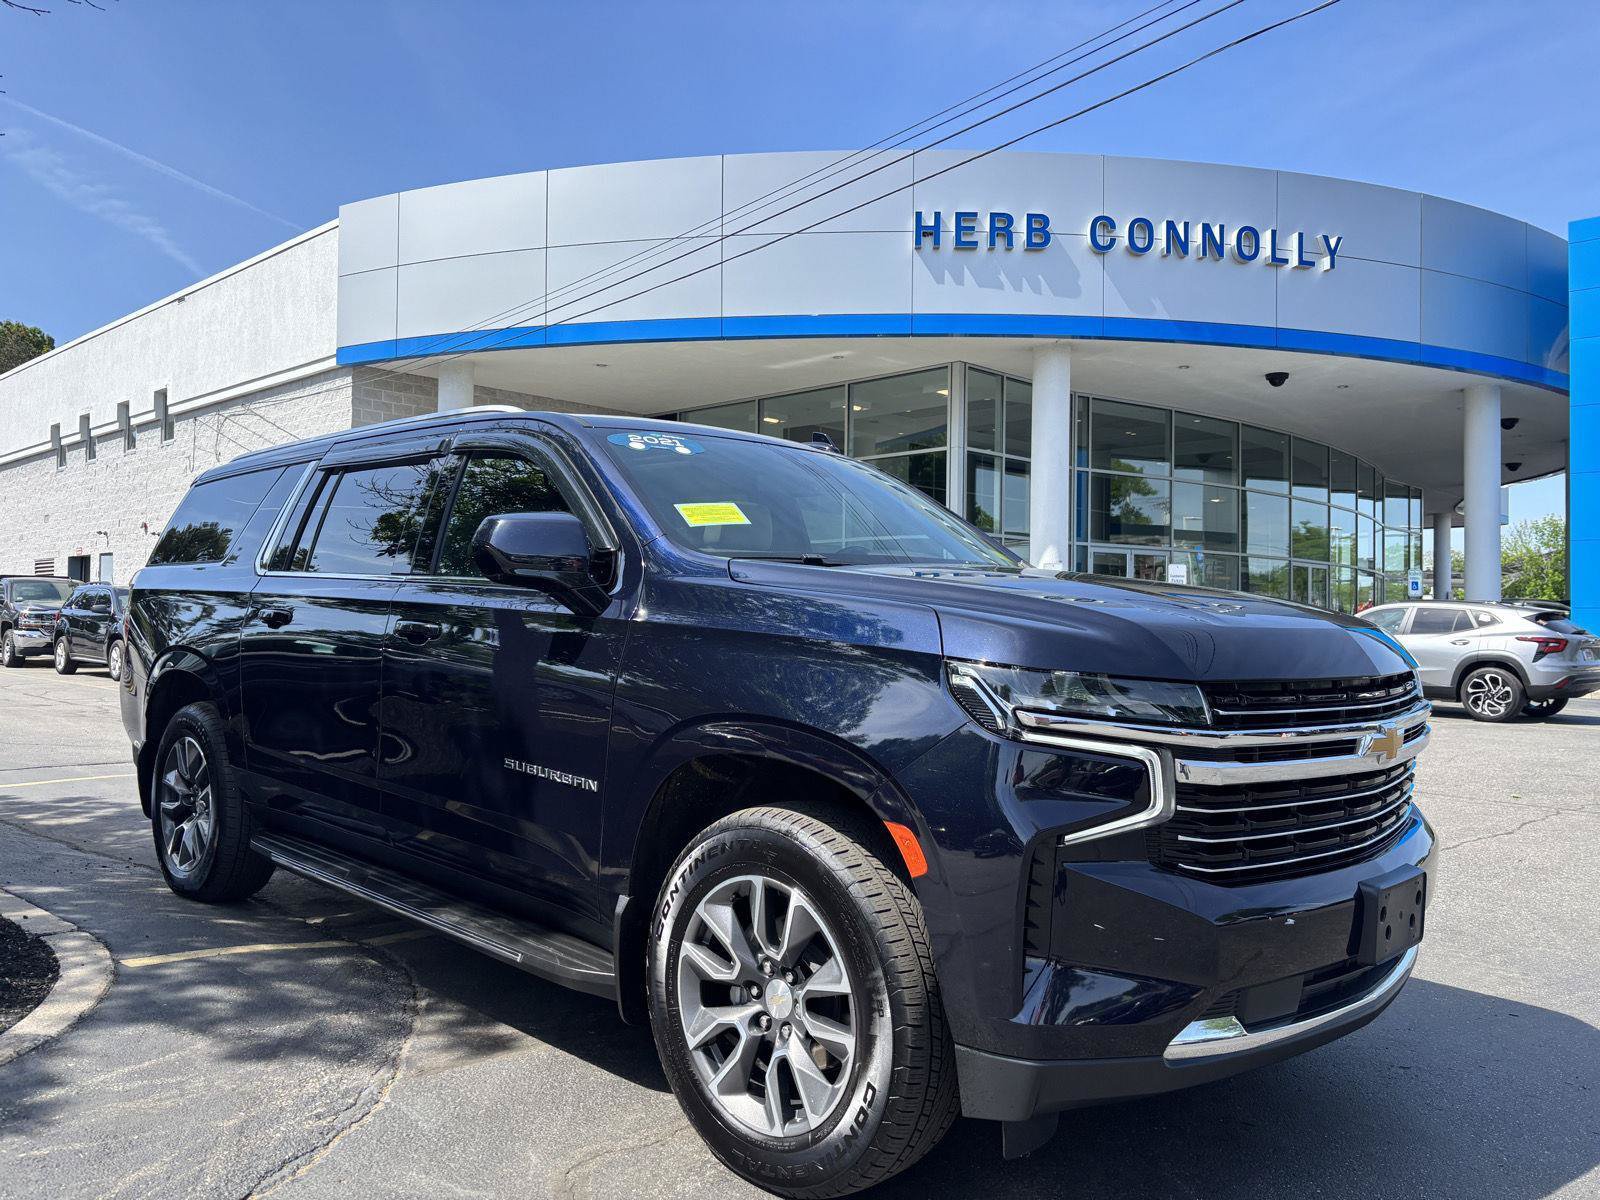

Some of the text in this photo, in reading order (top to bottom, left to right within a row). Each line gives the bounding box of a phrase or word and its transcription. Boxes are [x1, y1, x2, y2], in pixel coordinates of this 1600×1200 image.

[913, 211, 1344, 270] HERB CONNOLLY
[628, 434, 684, 447] 2021
[504, 757, 598, 792] SUBURBAN
